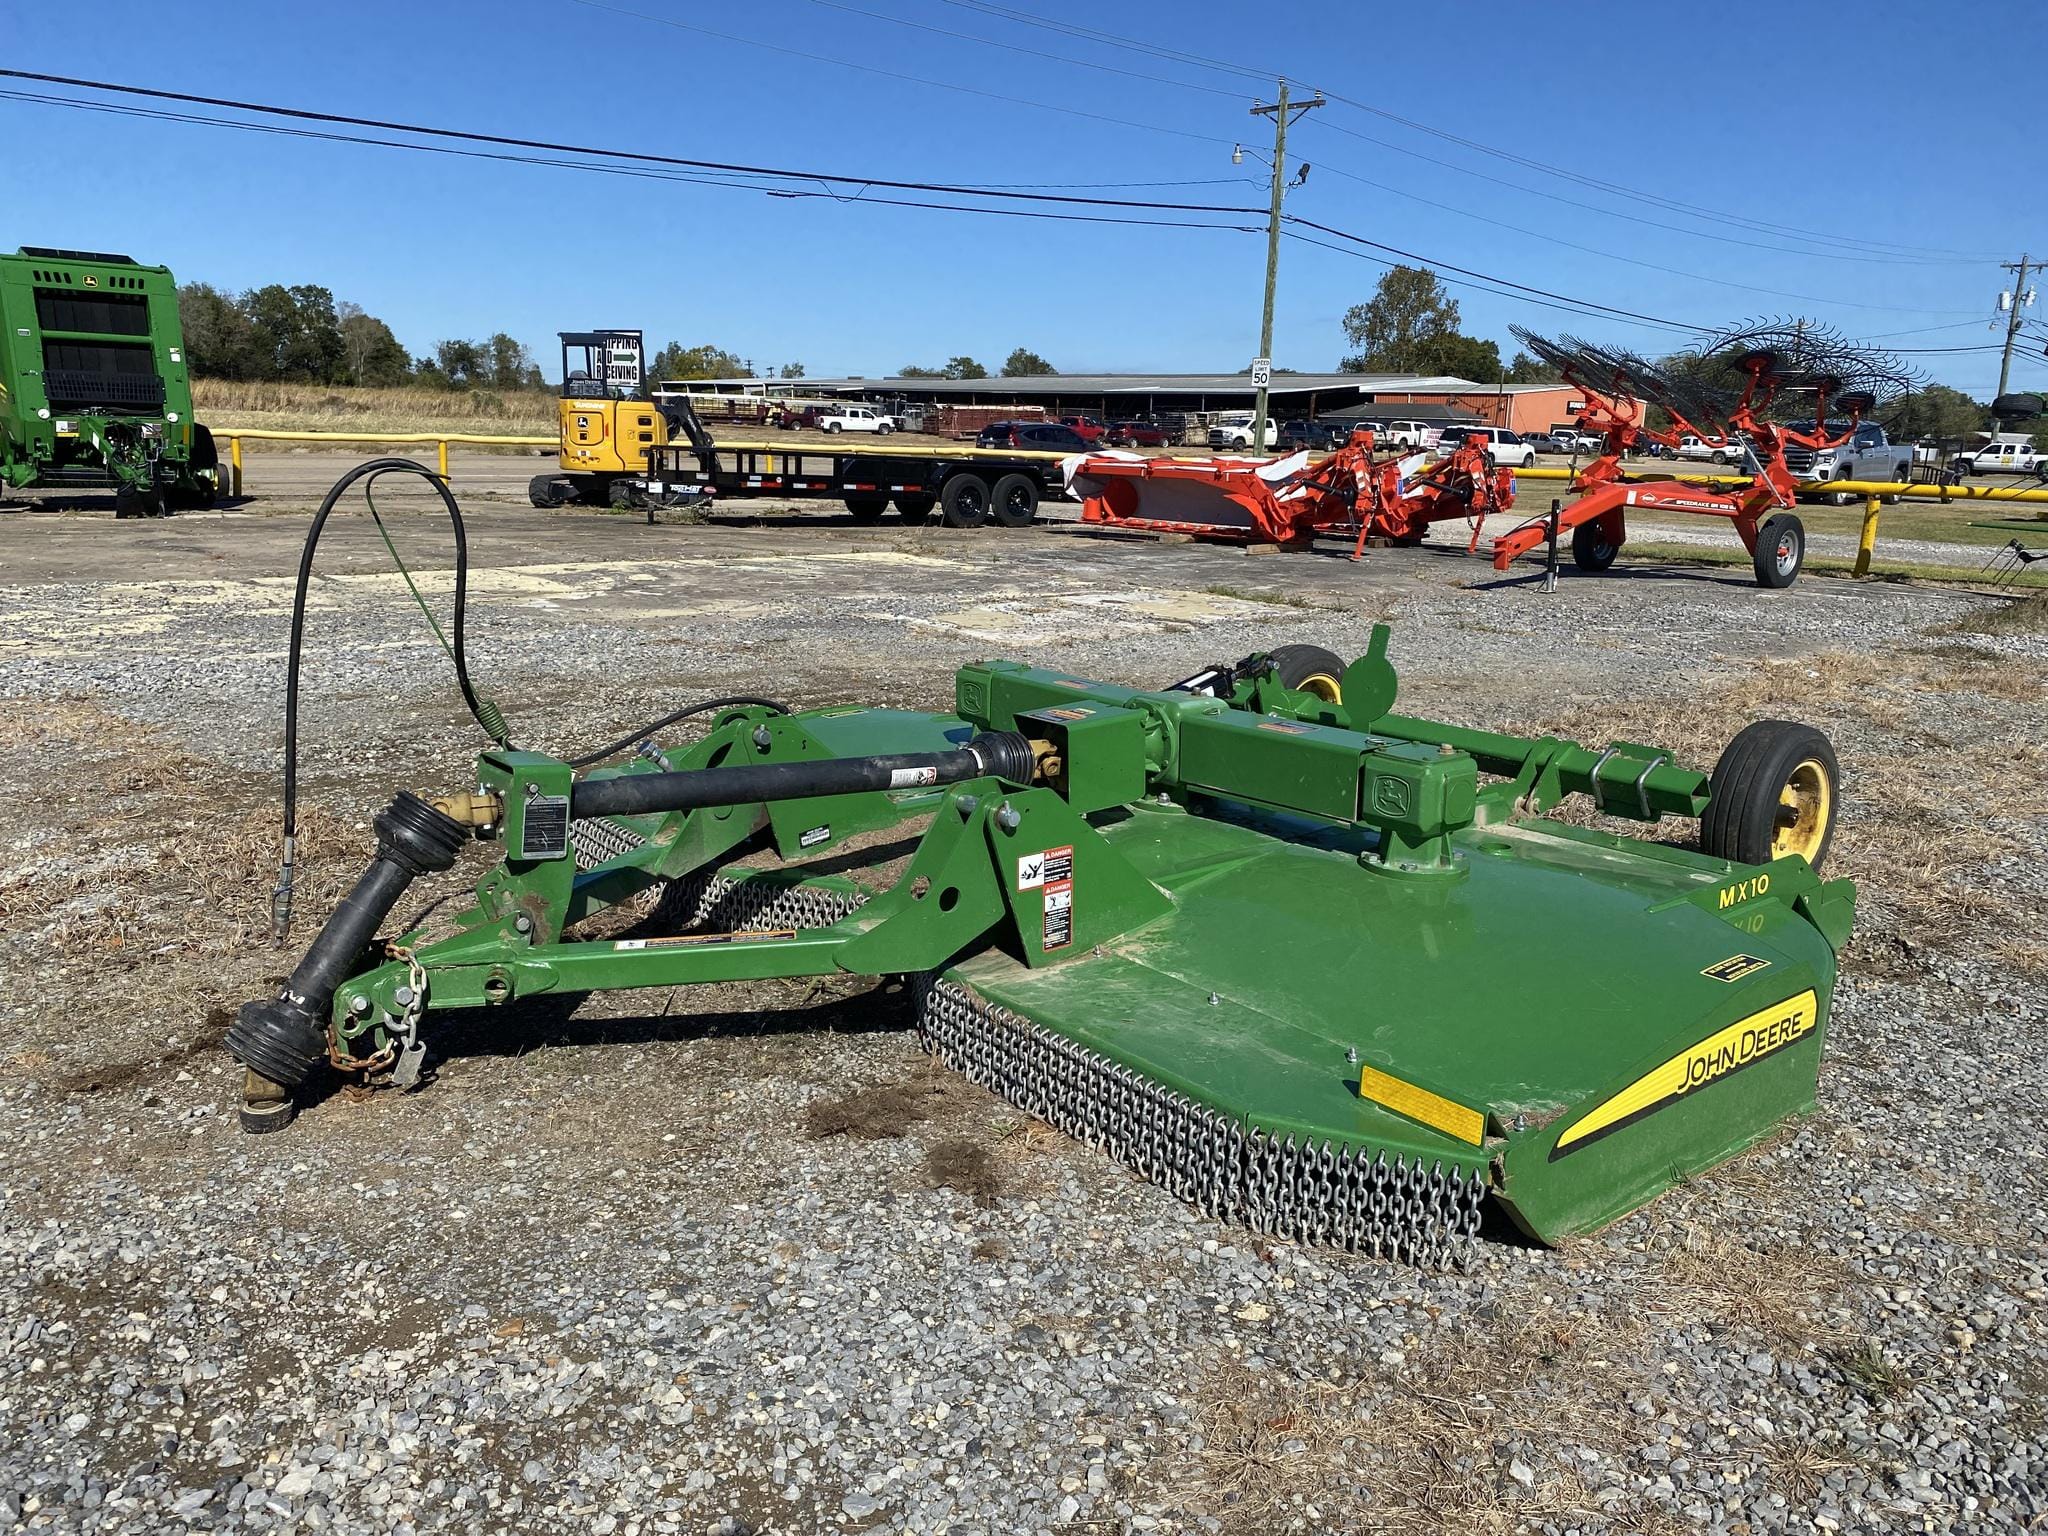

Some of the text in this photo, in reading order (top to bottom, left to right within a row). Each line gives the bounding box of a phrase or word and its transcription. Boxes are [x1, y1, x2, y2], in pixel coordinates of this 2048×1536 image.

[597, 350, 613, 364] AD
[597, 366, 637, 380] RCEIVING
[1253, 373, 1268, 384] 50
[1051, 848, 1072, 858] DANGER
[1050, 882, 1071, 893] DANGER
[1719, 872, 1769, 910] MX10
[1677, 1011, 1804, 1091] JOHN DEERE
